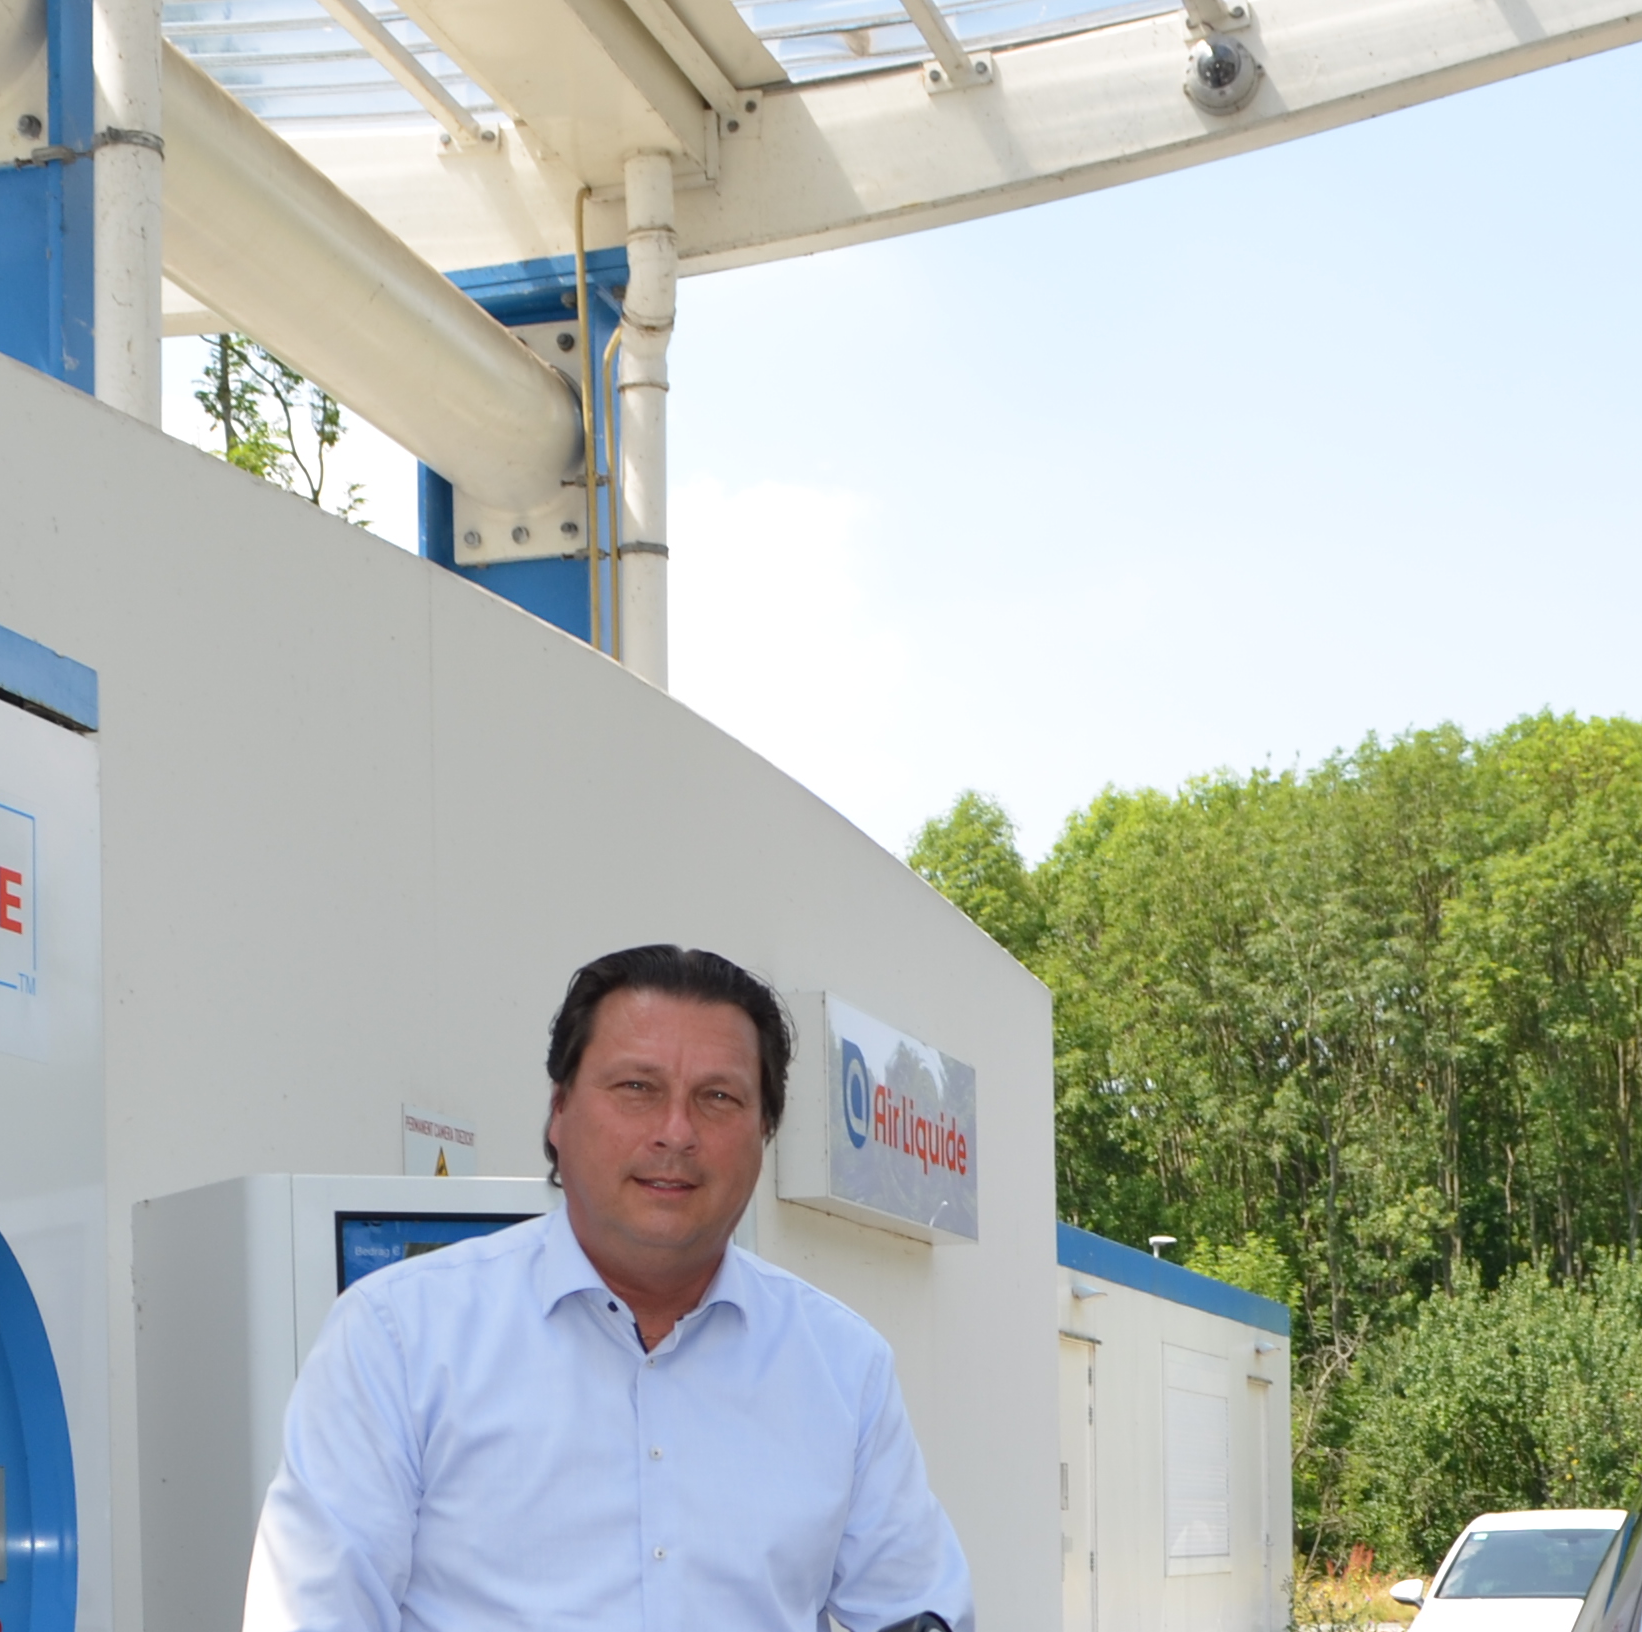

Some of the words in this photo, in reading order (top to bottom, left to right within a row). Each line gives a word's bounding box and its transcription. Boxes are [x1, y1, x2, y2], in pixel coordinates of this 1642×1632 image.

[434, 1123, 453, 1141] CAMERA
[874, 1084, 900, 1149] Air
[902, 1095, 967, 1176] Liquide
[354, 1246, 390, 1258] Bedrag
